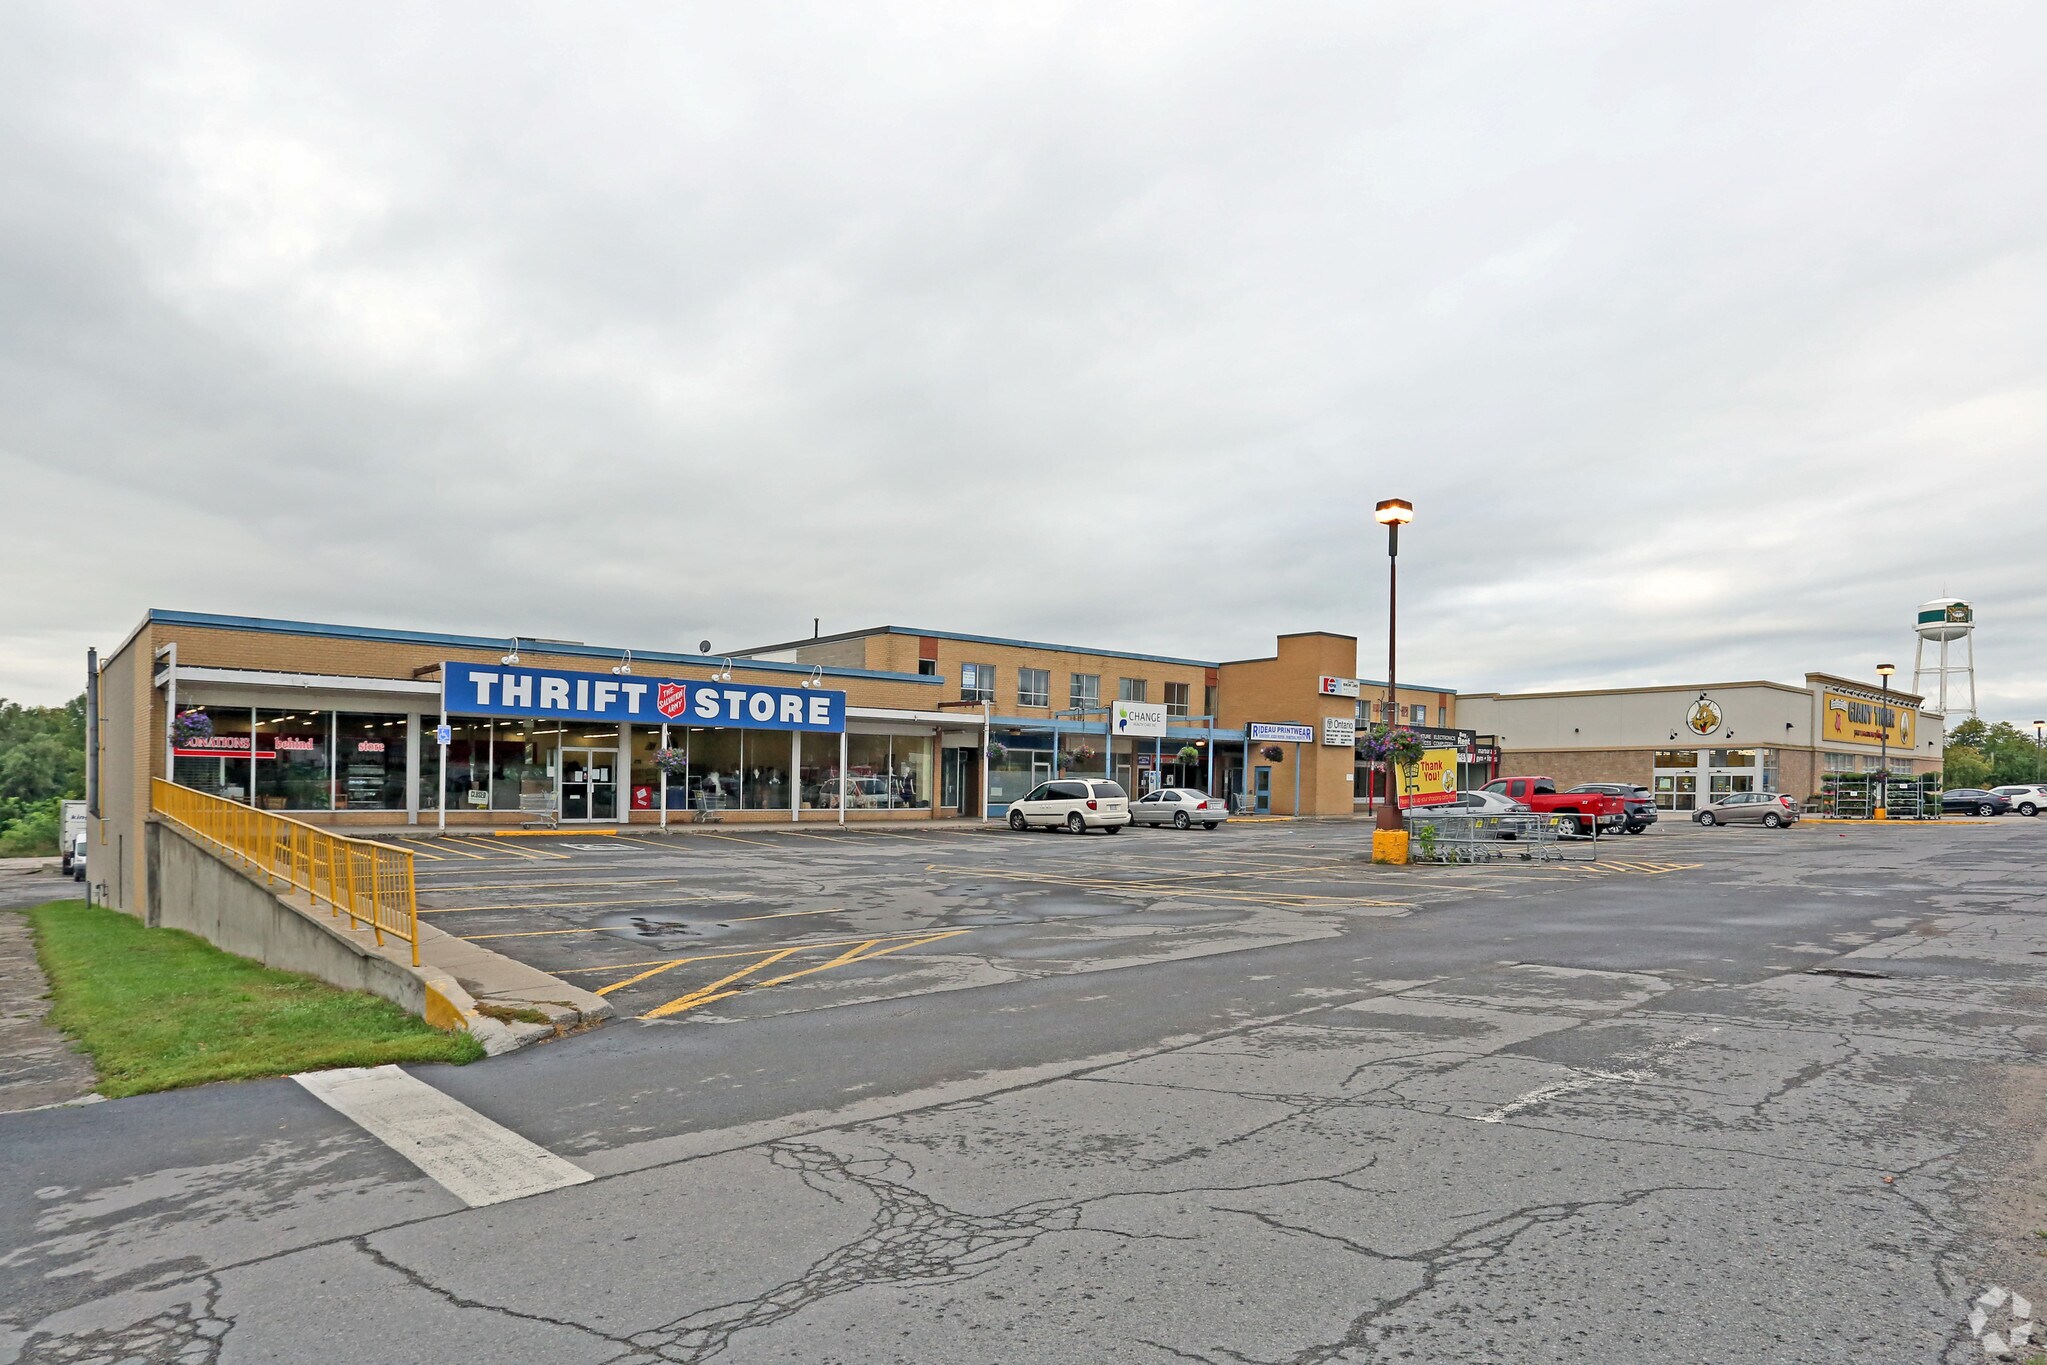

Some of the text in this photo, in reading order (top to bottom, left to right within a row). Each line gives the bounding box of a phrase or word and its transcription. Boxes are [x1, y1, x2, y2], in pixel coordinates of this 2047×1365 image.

[663, 686, 674, 697] THE
[469, 671, 831, 725] THRIFT STORE
[667, 699, 682, 714] ARMY
[1129, 711, 1161, 722] CHANGE
[1848, 701, 1873, 725] GIANT
[1334, 719, 1353, 729] Ontario
[1253, 725, 1276, 737] RIDEAU
[1277, 726, 1311, 740] PRINTWEAR
[184, 736, 385, 752] ONATIONS behind store
[1457, 736, 1470, 745] Rent
[1420, 760, 1443, 771] Thank
[1424, 771, 1440, 781] You!
